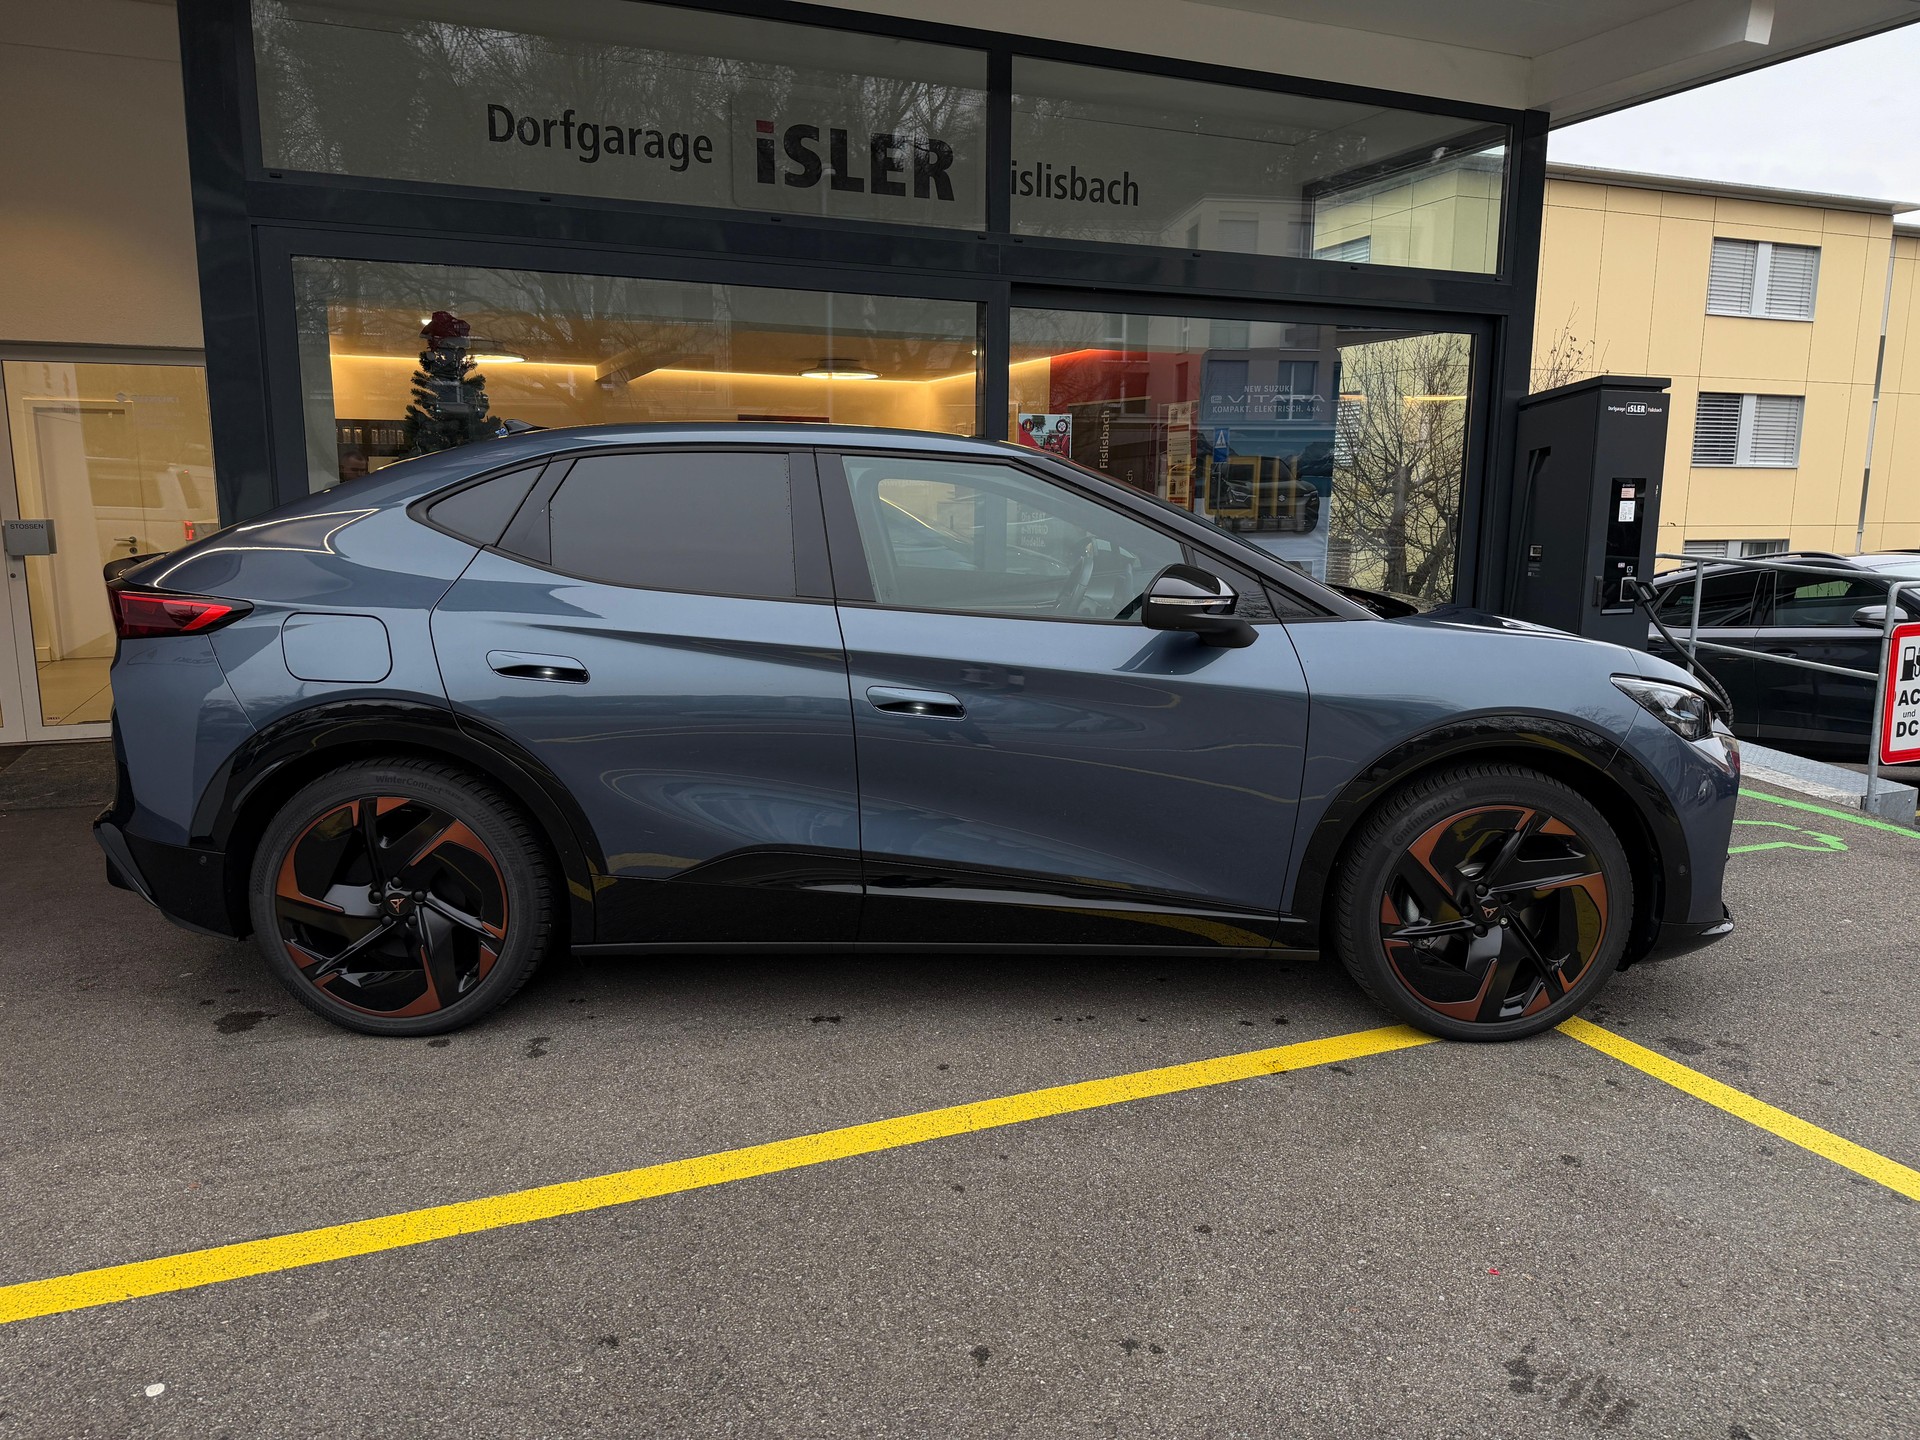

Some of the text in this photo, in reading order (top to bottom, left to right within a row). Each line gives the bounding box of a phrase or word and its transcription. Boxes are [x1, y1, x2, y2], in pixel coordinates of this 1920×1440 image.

[487, 103, 1139, 206] Dorfgarage iSLER islisbach
[1244, 385, 1293, 393] NEW SUZUKI
[1212, 405, 1252, 414] KOMPAKT.
[1254, 405, 1304, 413] ELEKTRISCH.
[1099, 410, 1111, 469] Fislisbach
[1897, 688, 1920, 707] AC
[1902, 709, 1916, 718] und
[1895, 719, 1919, 738] DC
[375, 775, 442, 795] WinterContact
[1391, 797, 1450, 847] Continental
